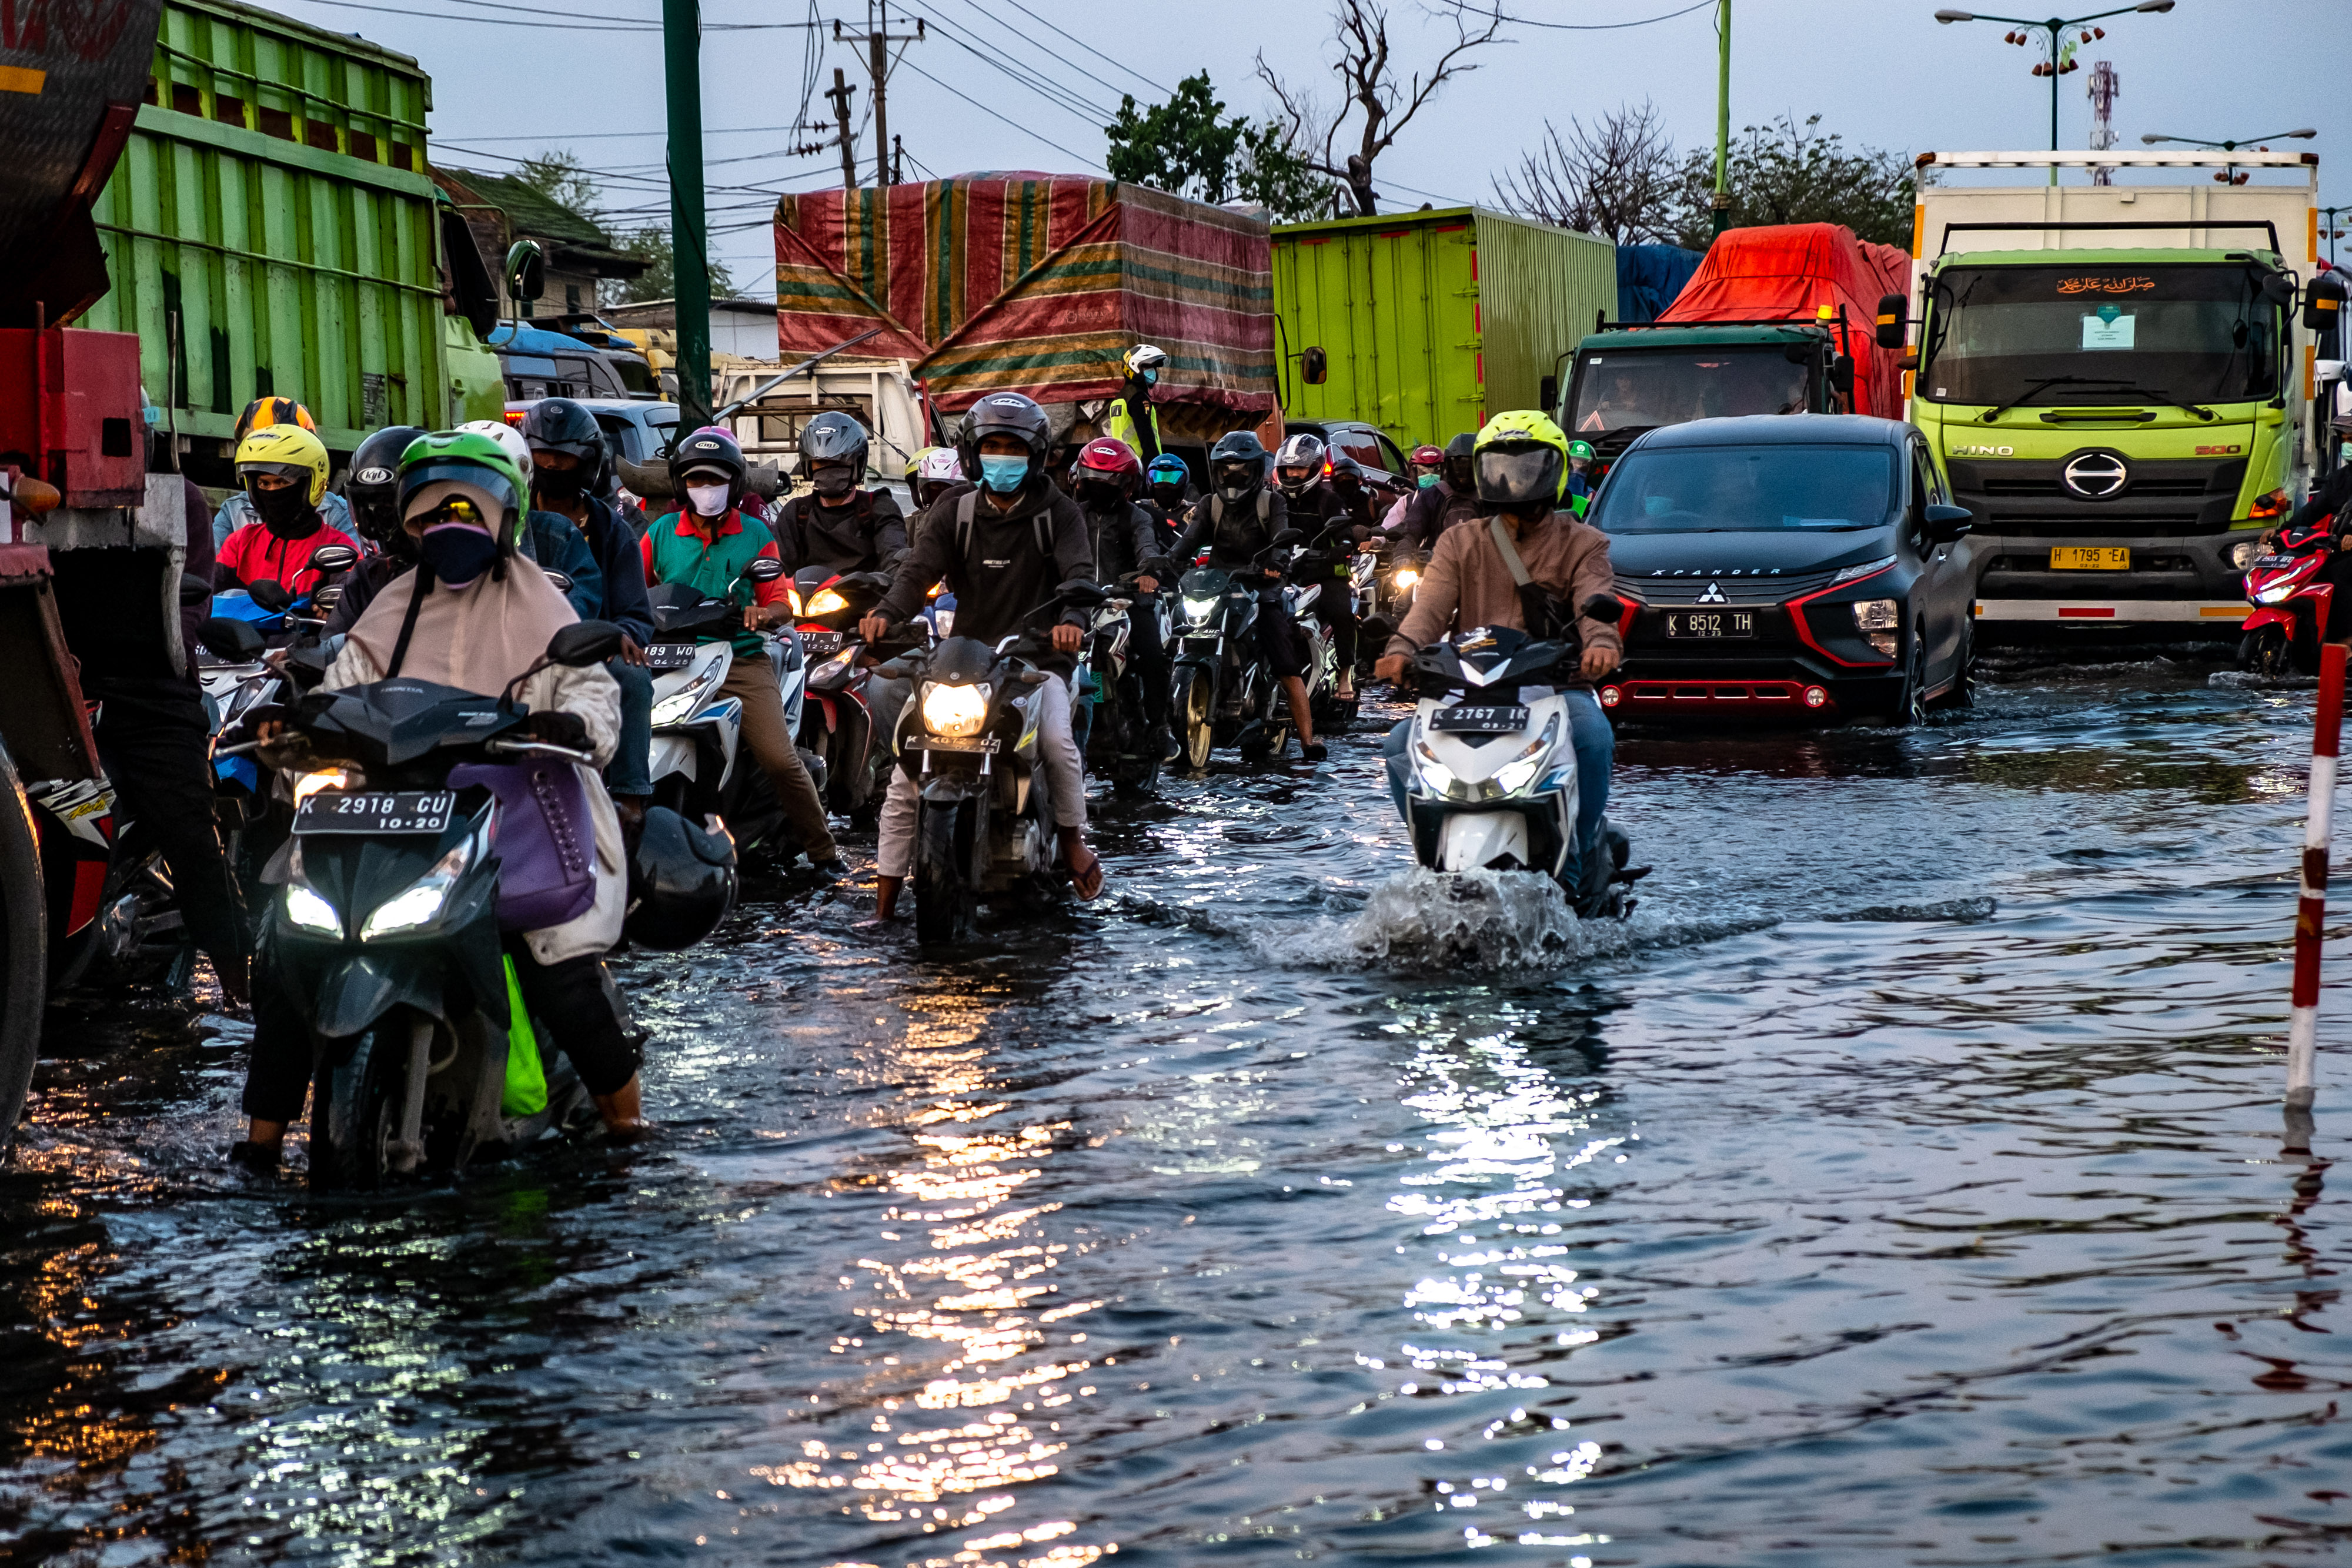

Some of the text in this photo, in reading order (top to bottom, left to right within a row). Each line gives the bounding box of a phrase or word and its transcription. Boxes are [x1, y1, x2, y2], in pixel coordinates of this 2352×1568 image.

[1953, 446, 2013, 456] HINO
[2196, 444, 2241, 455] 500
[2054, 549, 2126, 561] H 1795 EA
[1669, 614, 1750, 631] K 8512 TH
[1435, 710, 1444, 719] K
[1454, 708, 1495, 720] 2767
[300, 797, 316, 814] K
[338, 797, 395, 814] 2918
